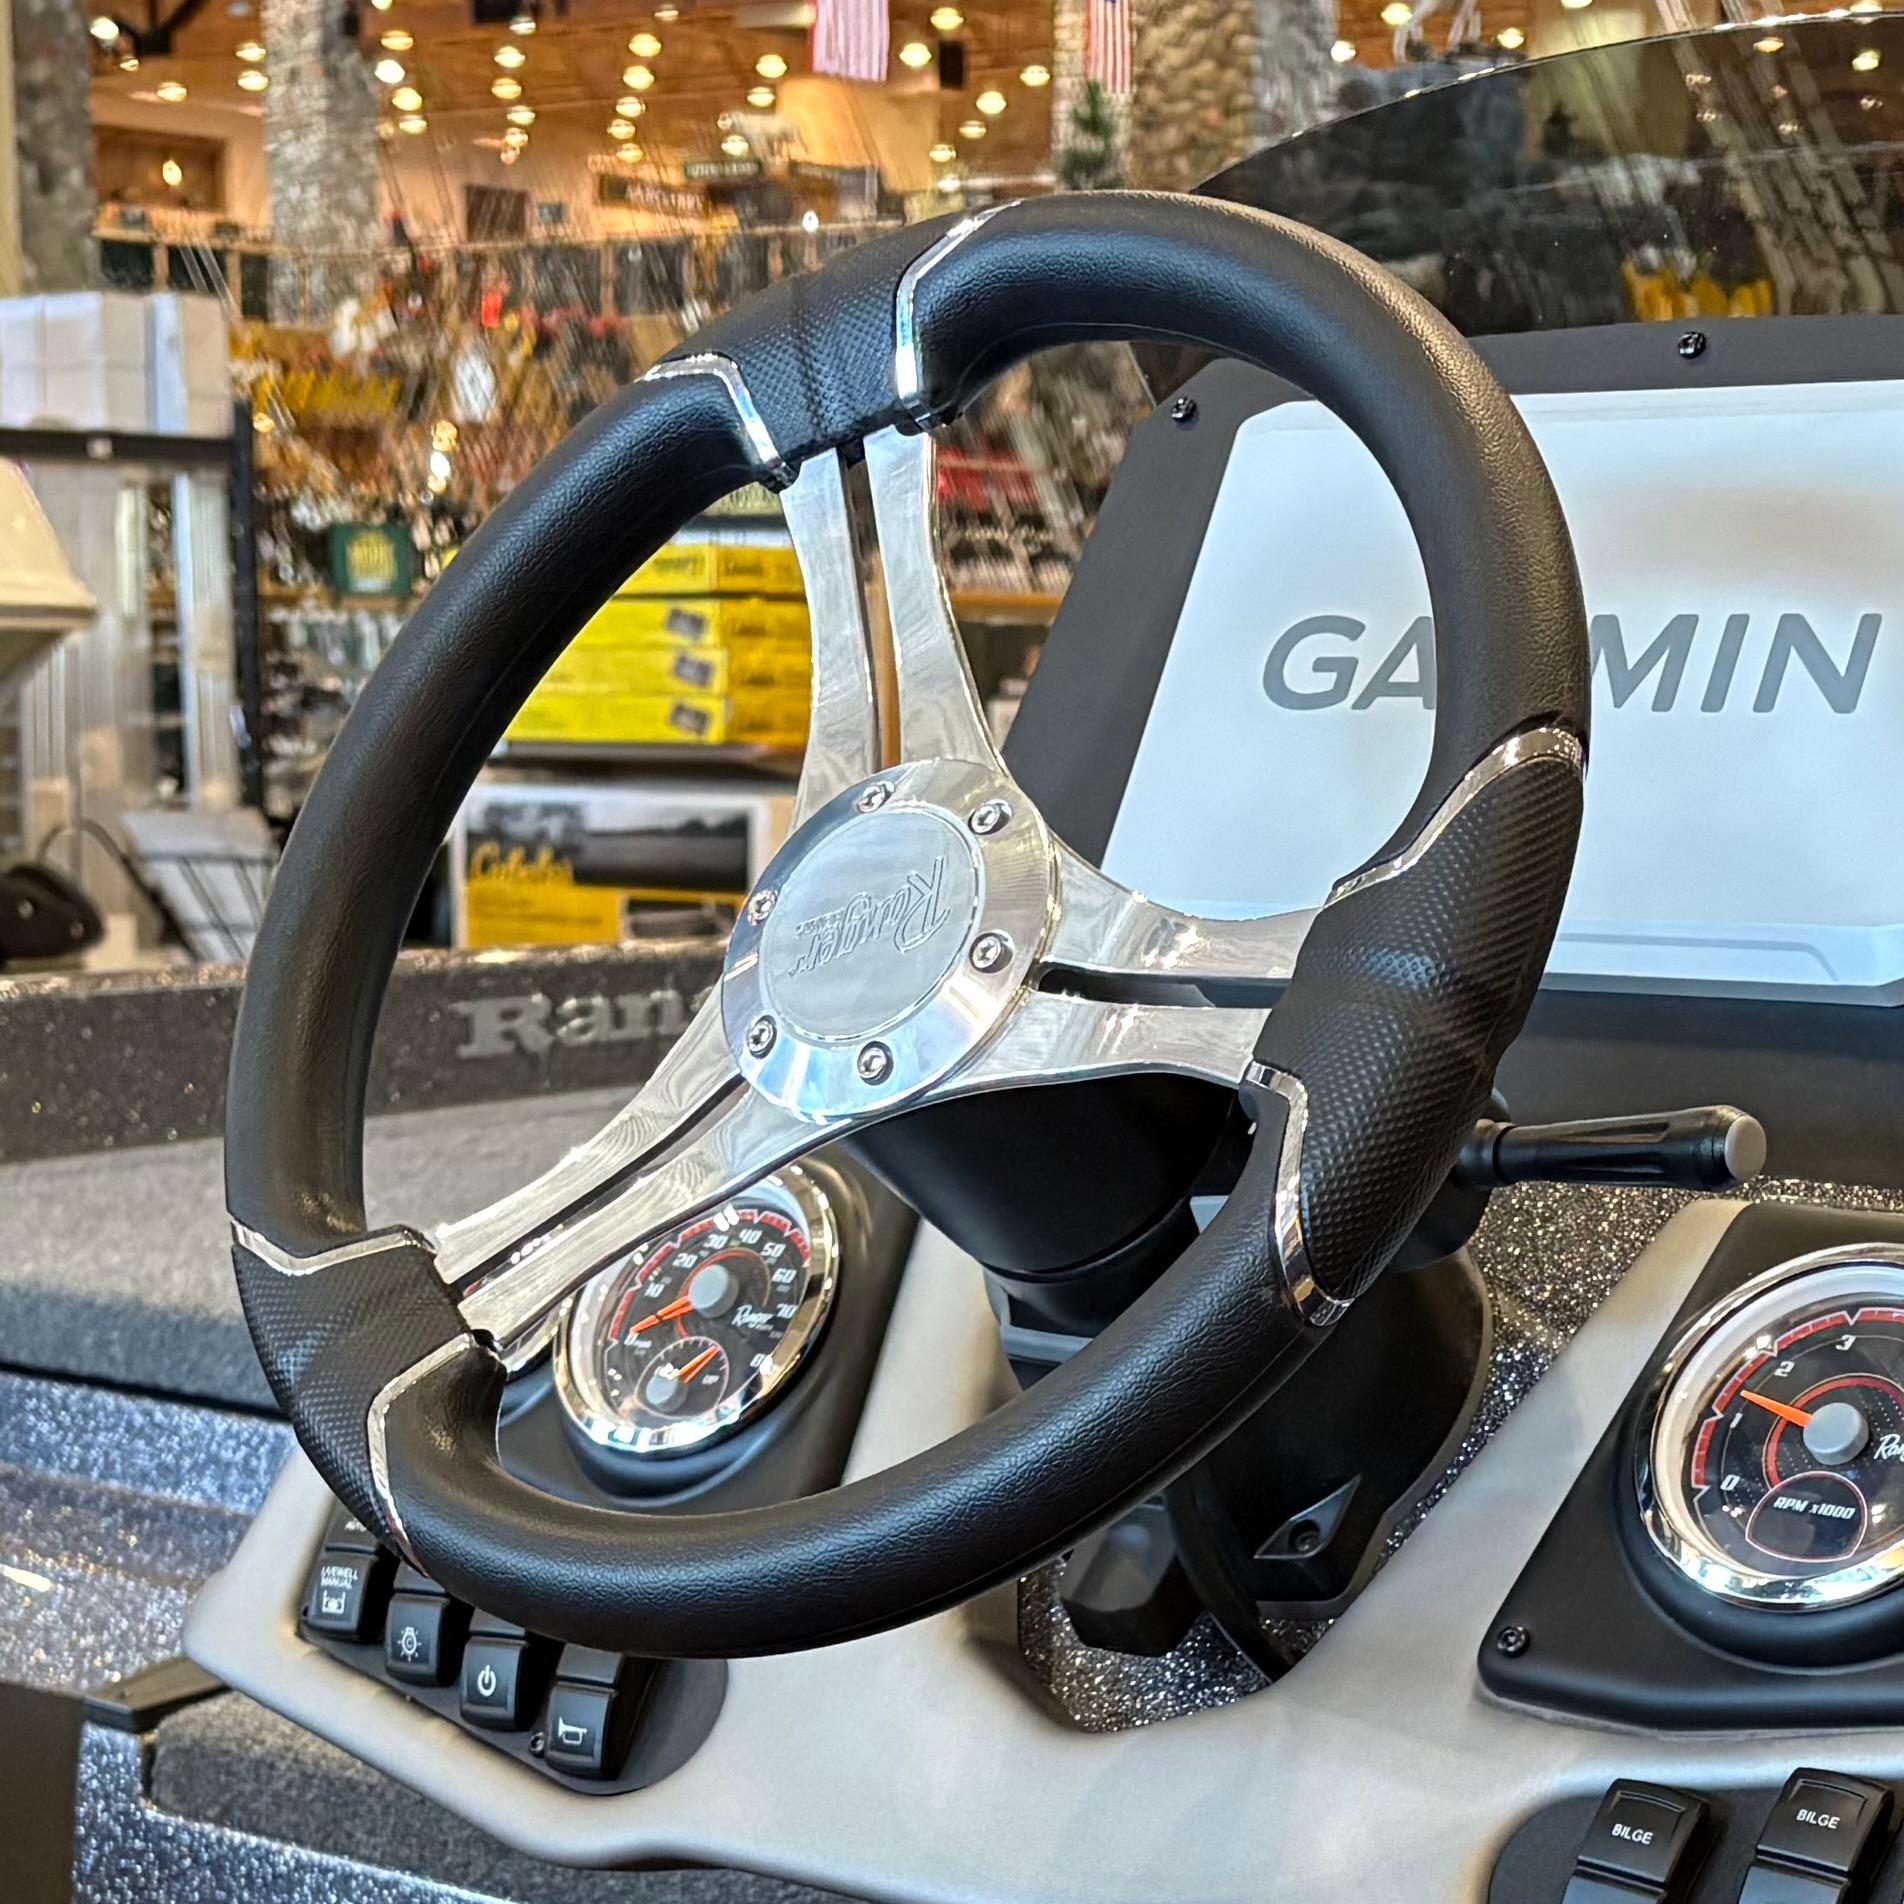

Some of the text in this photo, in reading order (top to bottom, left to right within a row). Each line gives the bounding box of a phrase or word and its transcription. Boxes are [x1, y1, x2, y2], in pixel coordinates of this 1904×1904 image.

[1262, 612, 1883, 715] GAMIN
[448, 985, 713, 1059] Ran
[703, 1233, 729, 1250] 30
[738, 1229, 763, 1245] 40
[760, 1242, 786, 1258] 50
[672, 1252, 699, 1269] 20
[771, 1268, 797, 1284] 60
[644, 1283, 665, 1298] 10
[1835, 1334, 1857, 1352] 3
[1773, 1360, 1796, 1377] 2
[1729, 1412, 1742, 1429] 1
[1719, 1474, 1739, 1492] 0
[1773, 1496, 1856, 1520] RPM x1000
[1796, 1808, 1841, 1830] BILGE
[1611, 1823, 1654, 1845] BILGE
